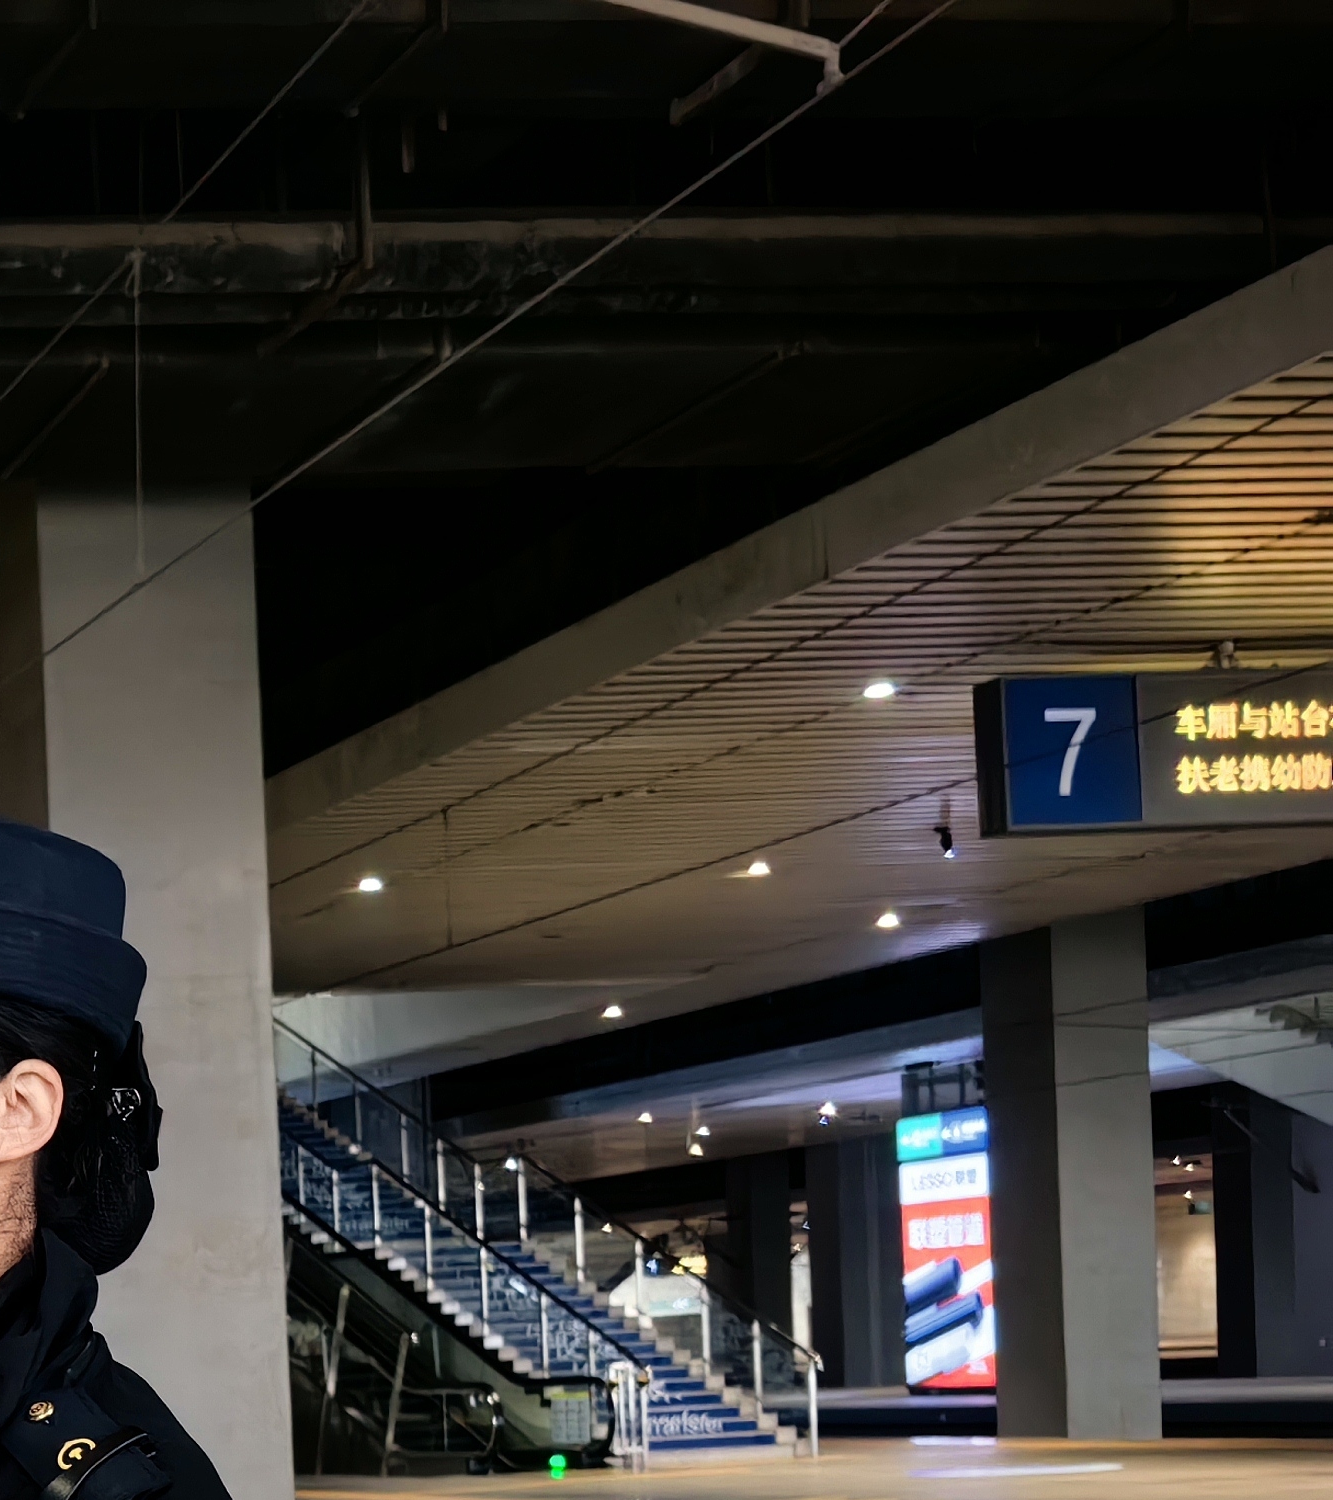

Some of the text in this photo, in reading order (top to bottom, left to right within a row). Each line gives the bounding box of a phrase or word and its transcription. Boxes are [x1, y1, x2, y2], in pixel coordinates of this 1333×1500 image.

[1175, 700, 1333, 741] 车厢与站台
[1044, 707, 1097, 797] 7
[1175, 752, 1333, 794] 扶老携幼防
